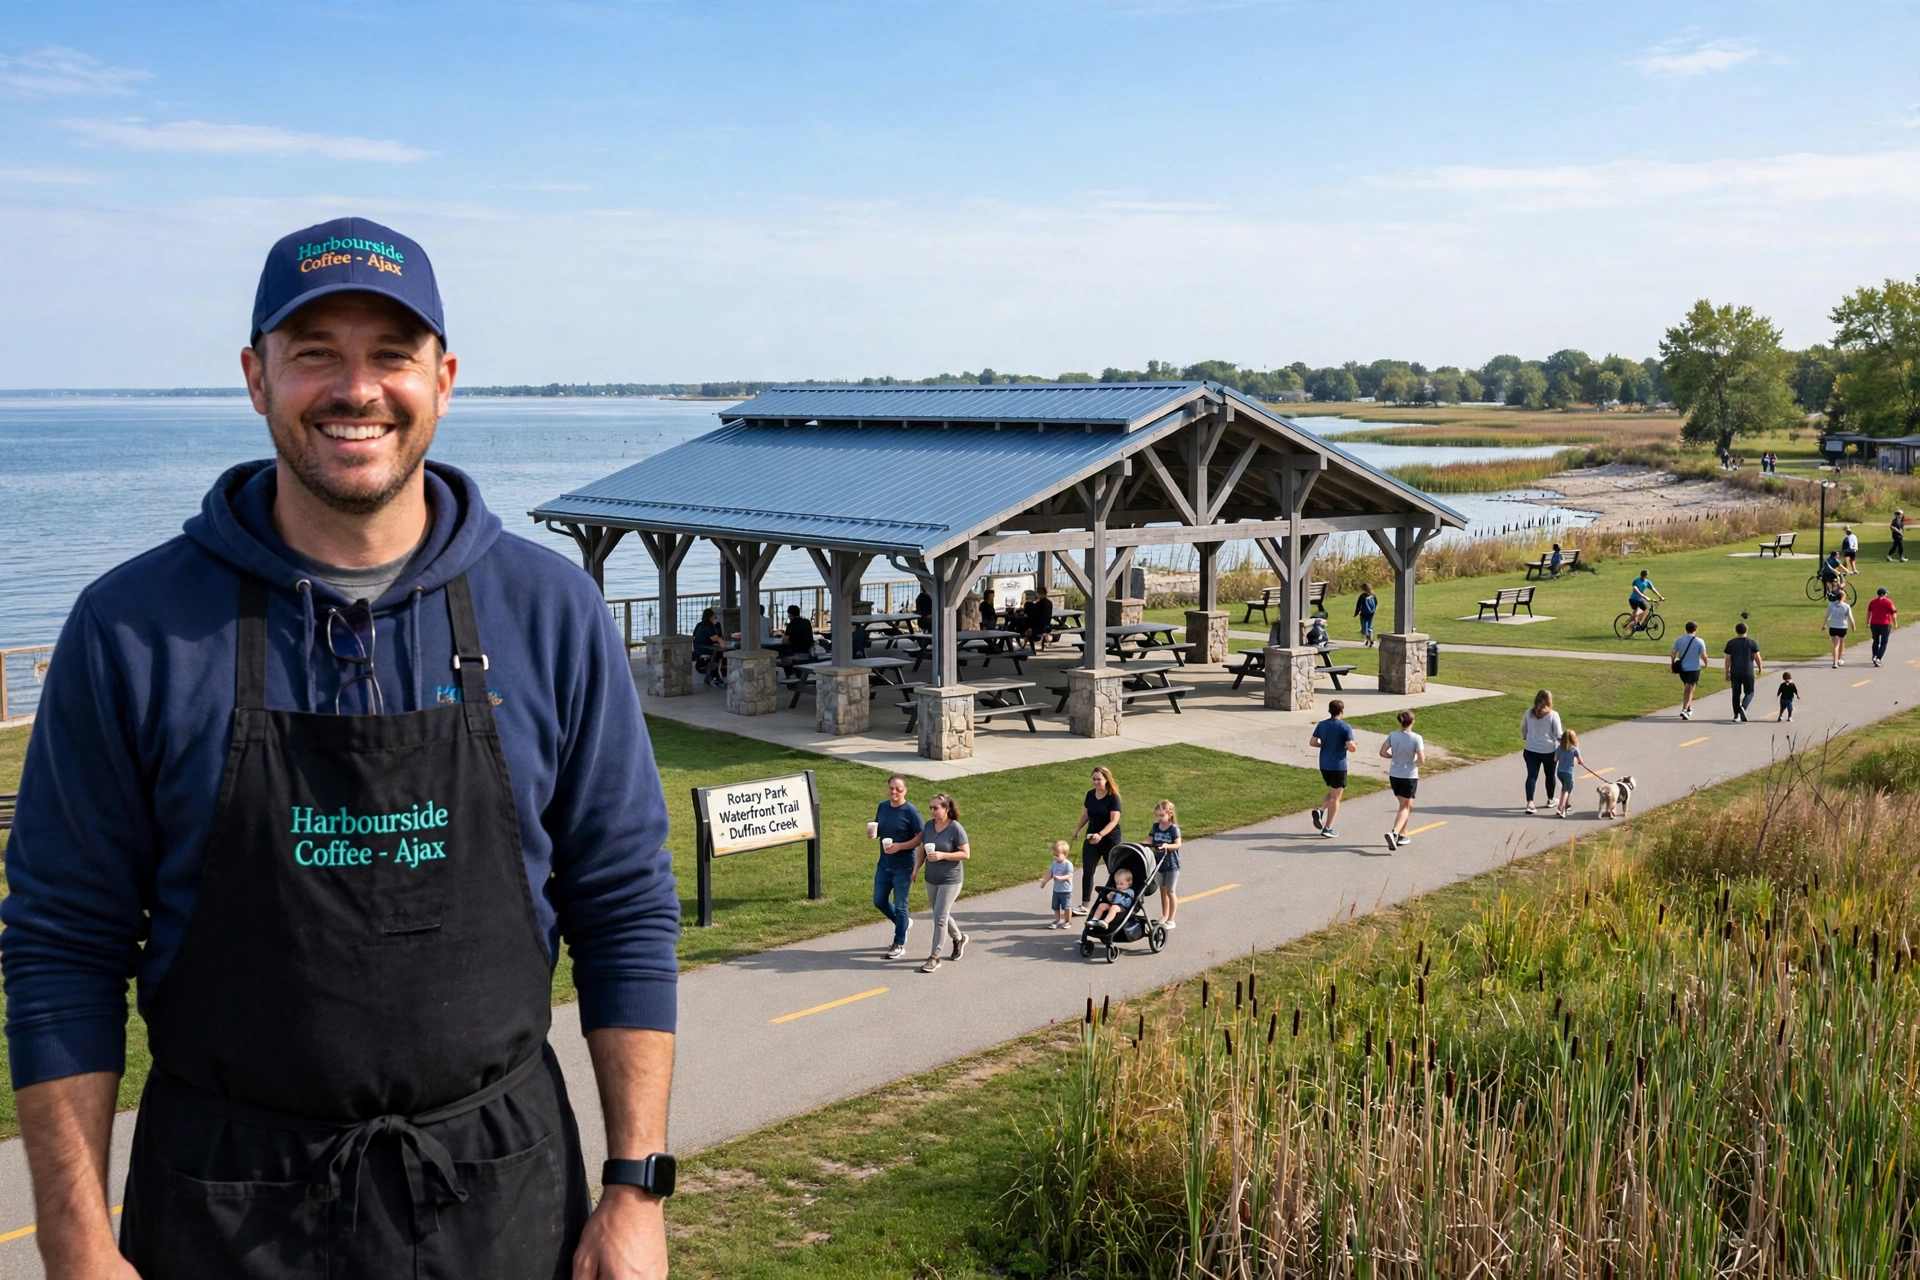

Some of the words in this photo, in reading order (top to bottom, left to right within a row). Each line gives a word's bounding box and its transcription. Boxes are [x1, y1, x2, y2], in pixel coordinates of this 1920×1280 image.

[297, 236, 404, 263] Harbourside
[300, 252, 351, 273] Coffee
[367, 253, 402, 276] Ajax
[727, 791, 762, 806] Rotary
[764, 785, 788, 800] Park
[290, 800, 449, 834] Harbourside
[719, 805, 776, 824] Waterfront
[777, 799, 800, 814] Trail
[729, 823, 767, 840] Duffins
[768, 817, 799, 833] Creek
[295, 840, 372, 866] Coffee
[394, 837, 447, 868] Ajax
